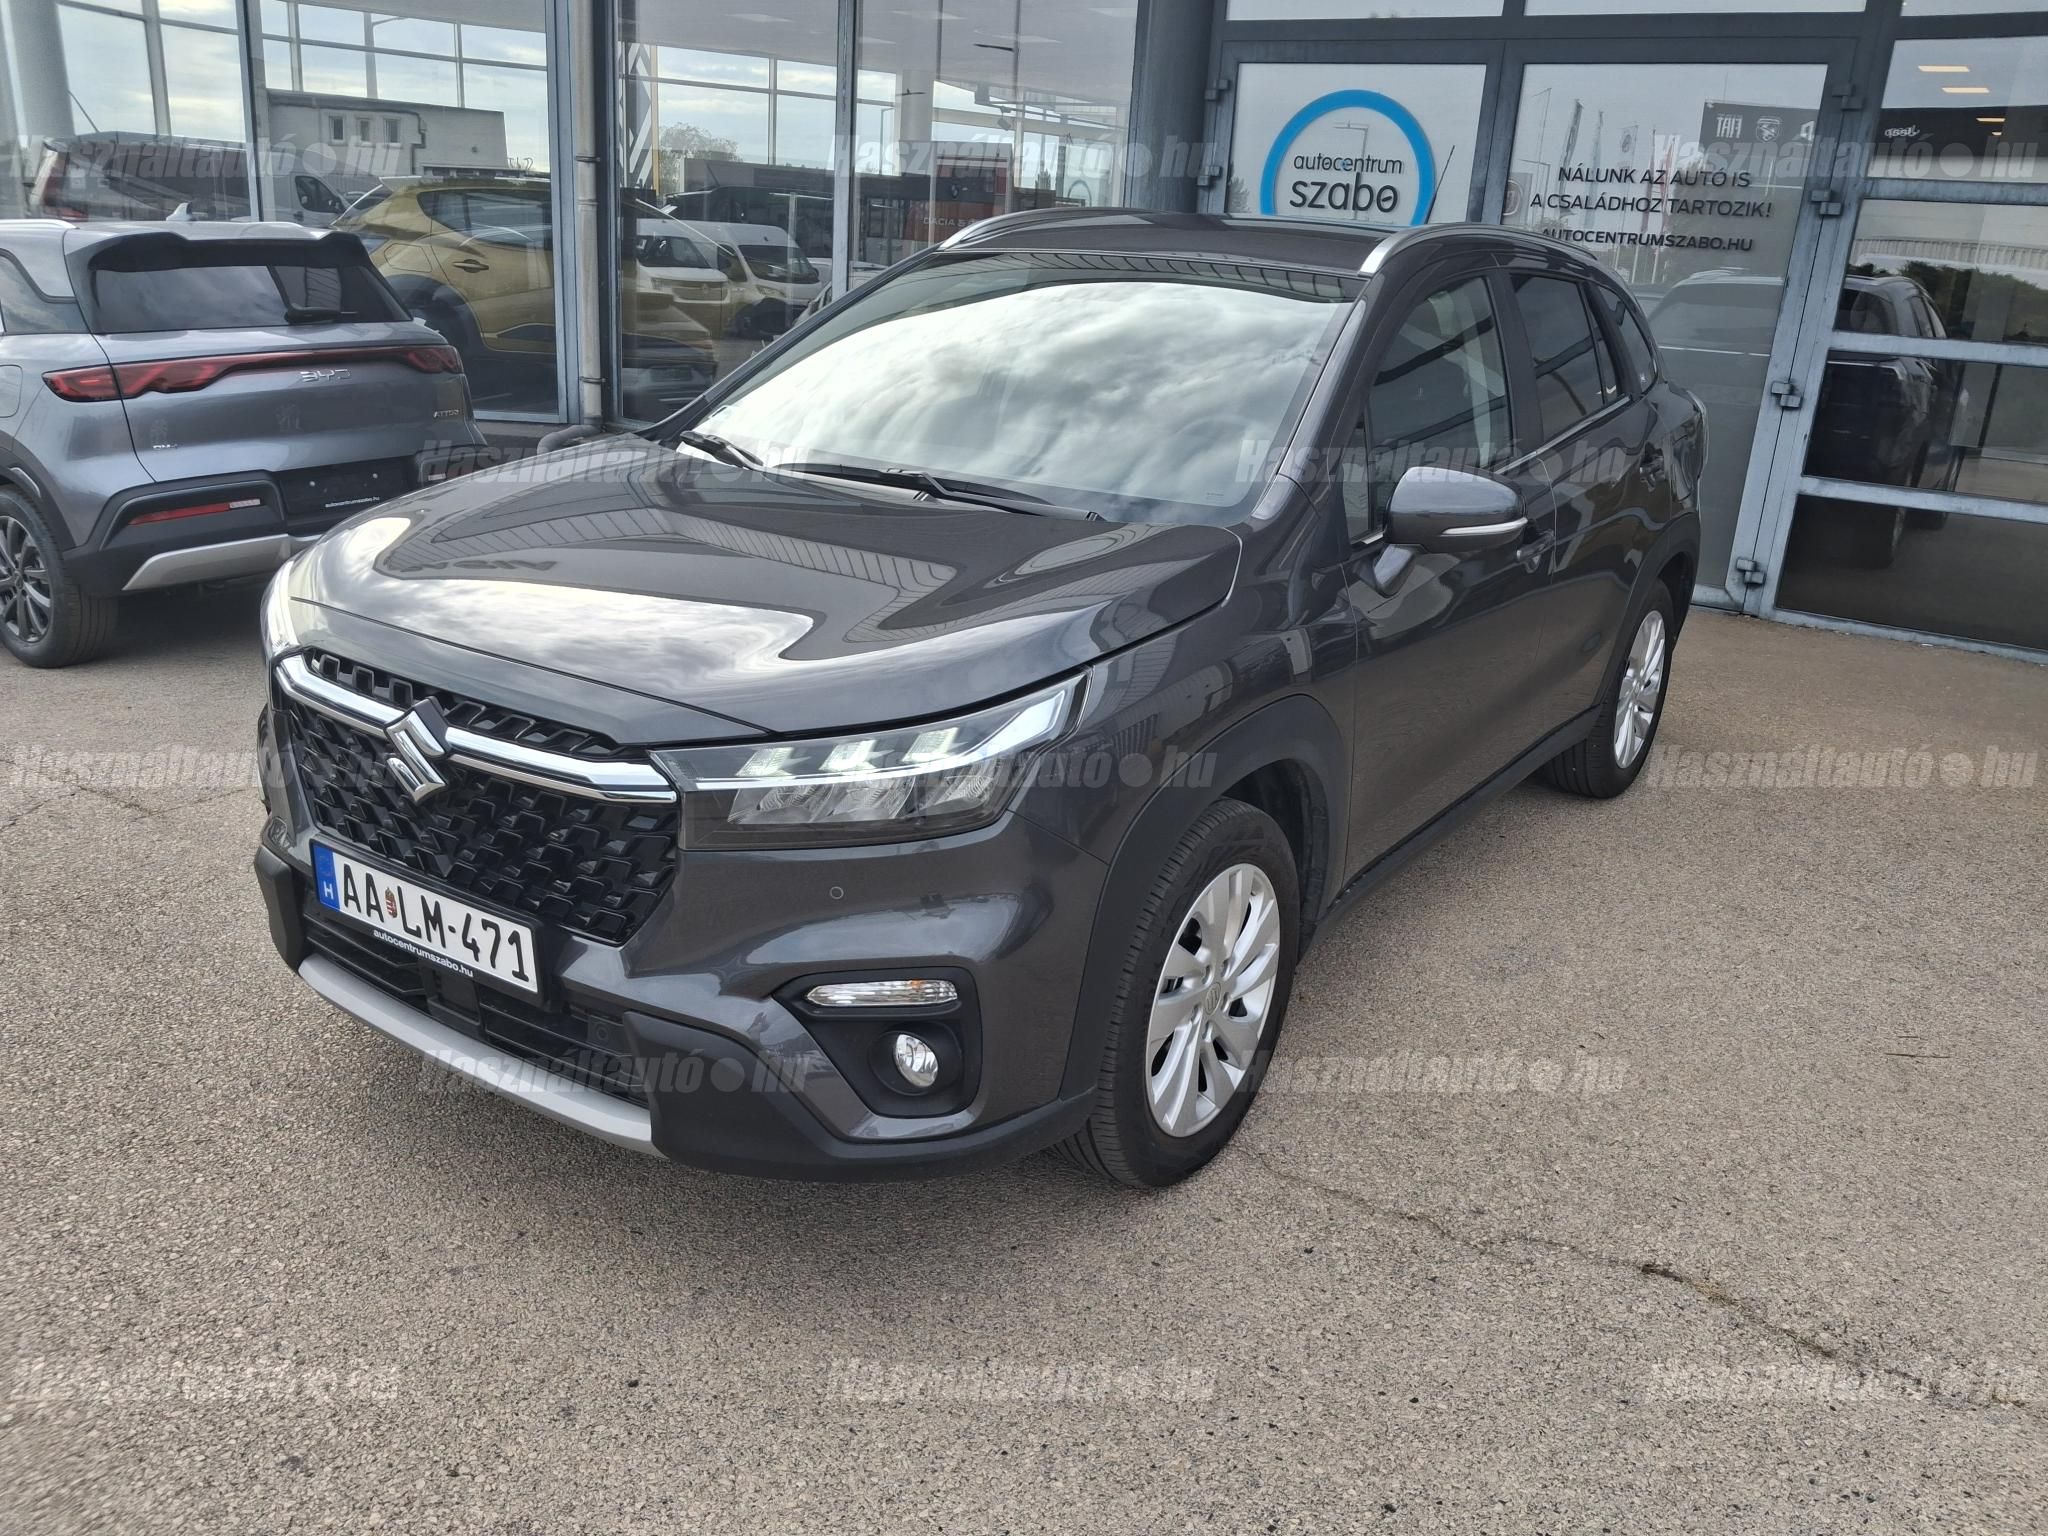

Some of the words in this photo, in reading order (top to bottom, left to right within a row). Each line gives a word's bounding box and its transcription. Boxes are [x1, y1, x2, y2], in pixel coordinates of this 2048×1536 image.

[1294, 153, 1402, 174] autocentrum
[1558, 163, 1636, 183] NÁLUNK
[1640, 169, 1666, 185] AZ
[1670, 167, 1728, 187] AUTÓ
[1732, 172, 1752, 188] IS
[1530, 193, 1543, 208] A
[1547, 189, 1663, 213] CSALÁDHOZ
[1667, 198, 1772, 218] TARTOZIK!
[323, 882, 333, 900] H
[373, 929, 474, 978] autocentrumszabo.hu
